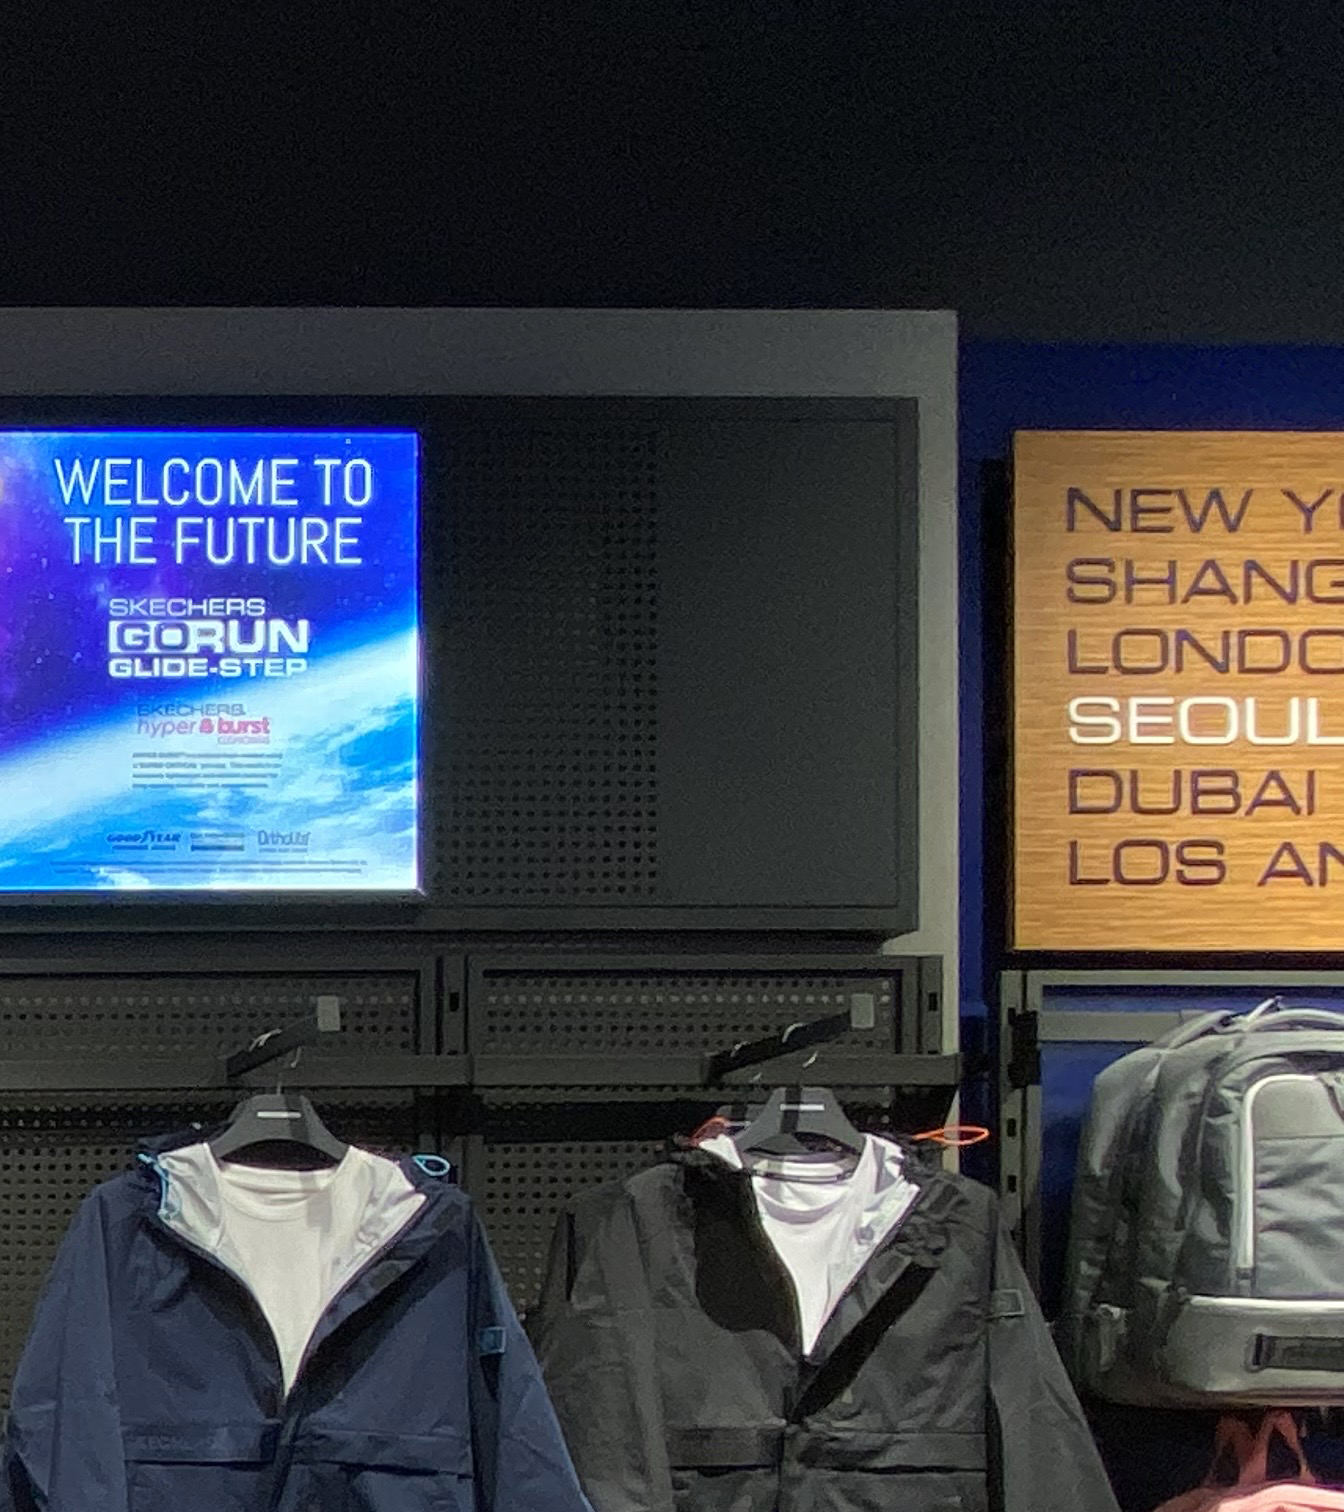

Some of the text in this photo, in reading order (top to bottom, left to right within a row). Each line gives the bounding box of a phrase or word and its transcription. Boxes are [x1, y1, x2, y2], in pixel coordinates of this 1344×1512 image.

[54, 458, 372, 506] WELCOME TO
[1065, 487, 1344, 534] NEW Y
[64, 517, 363, 565] THE FUTURE
[1065, 557, 1344, 606] SHANG
[108, 598, 267, 617] SKECHERS
[108, 619, 310, 654] GORUN
[108, 657, 310, 678] GLIDE-STEP
[137, 703, 247, 717] SKECHERS
[137, 716, 271, 738] hyper burst
[1067, 695, 1344, 746] SEOUL
[1068, 769, 1317, 816] DUBAI
[1068, 839, 1226, 886] LOS
